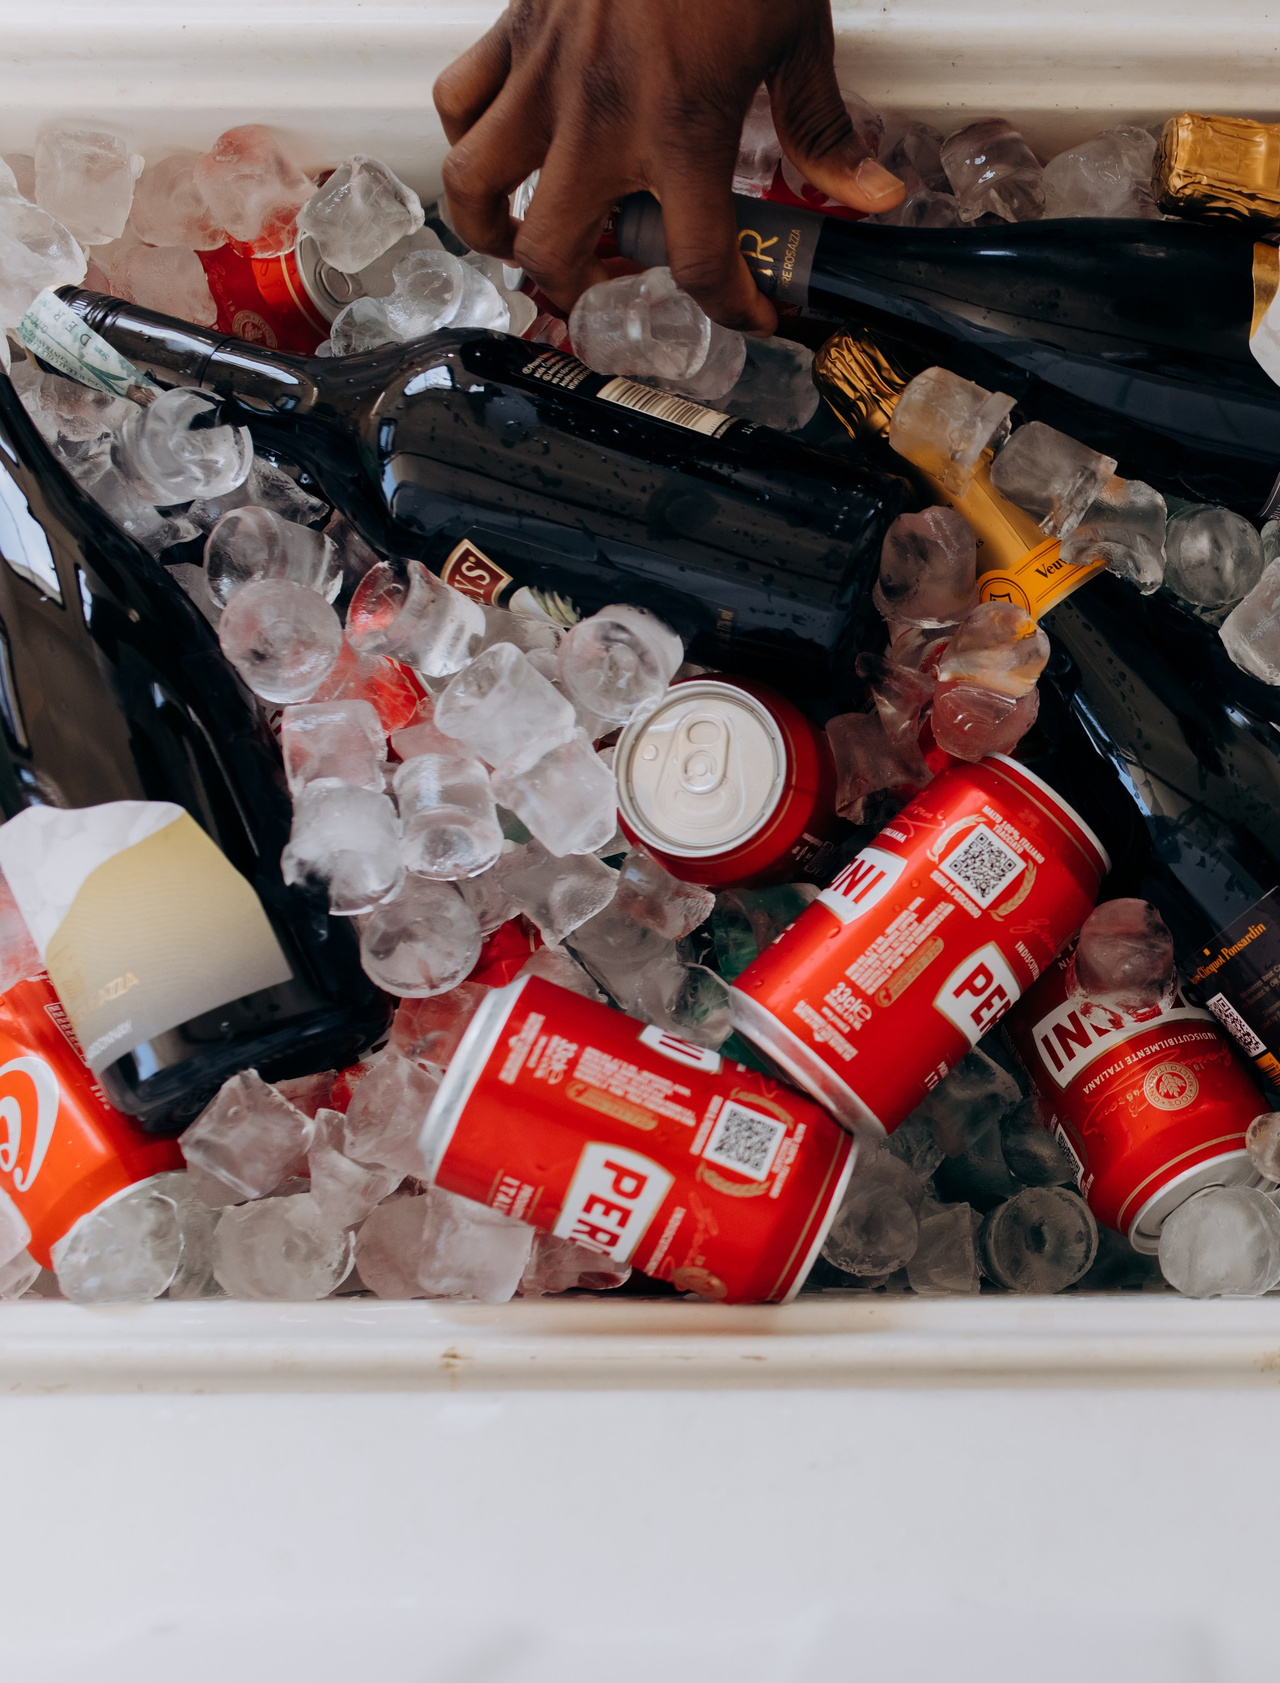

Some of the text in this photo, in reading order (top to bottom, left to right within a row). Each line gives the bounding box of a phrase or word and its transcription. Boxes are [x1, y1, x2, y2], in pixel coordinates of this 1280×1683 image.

[981, 804, 1045, 865] MALTO 100% ITALIANO
[991, 823, 1024, 855] TRACCIATO
[1196, 919, 1268, 981] Clicquot Ponsardin
[1267, 975, 1280, 988] QR
[1082, 1031, 1217, 1095] INDISCUTIBILMENTE ITALIANA
